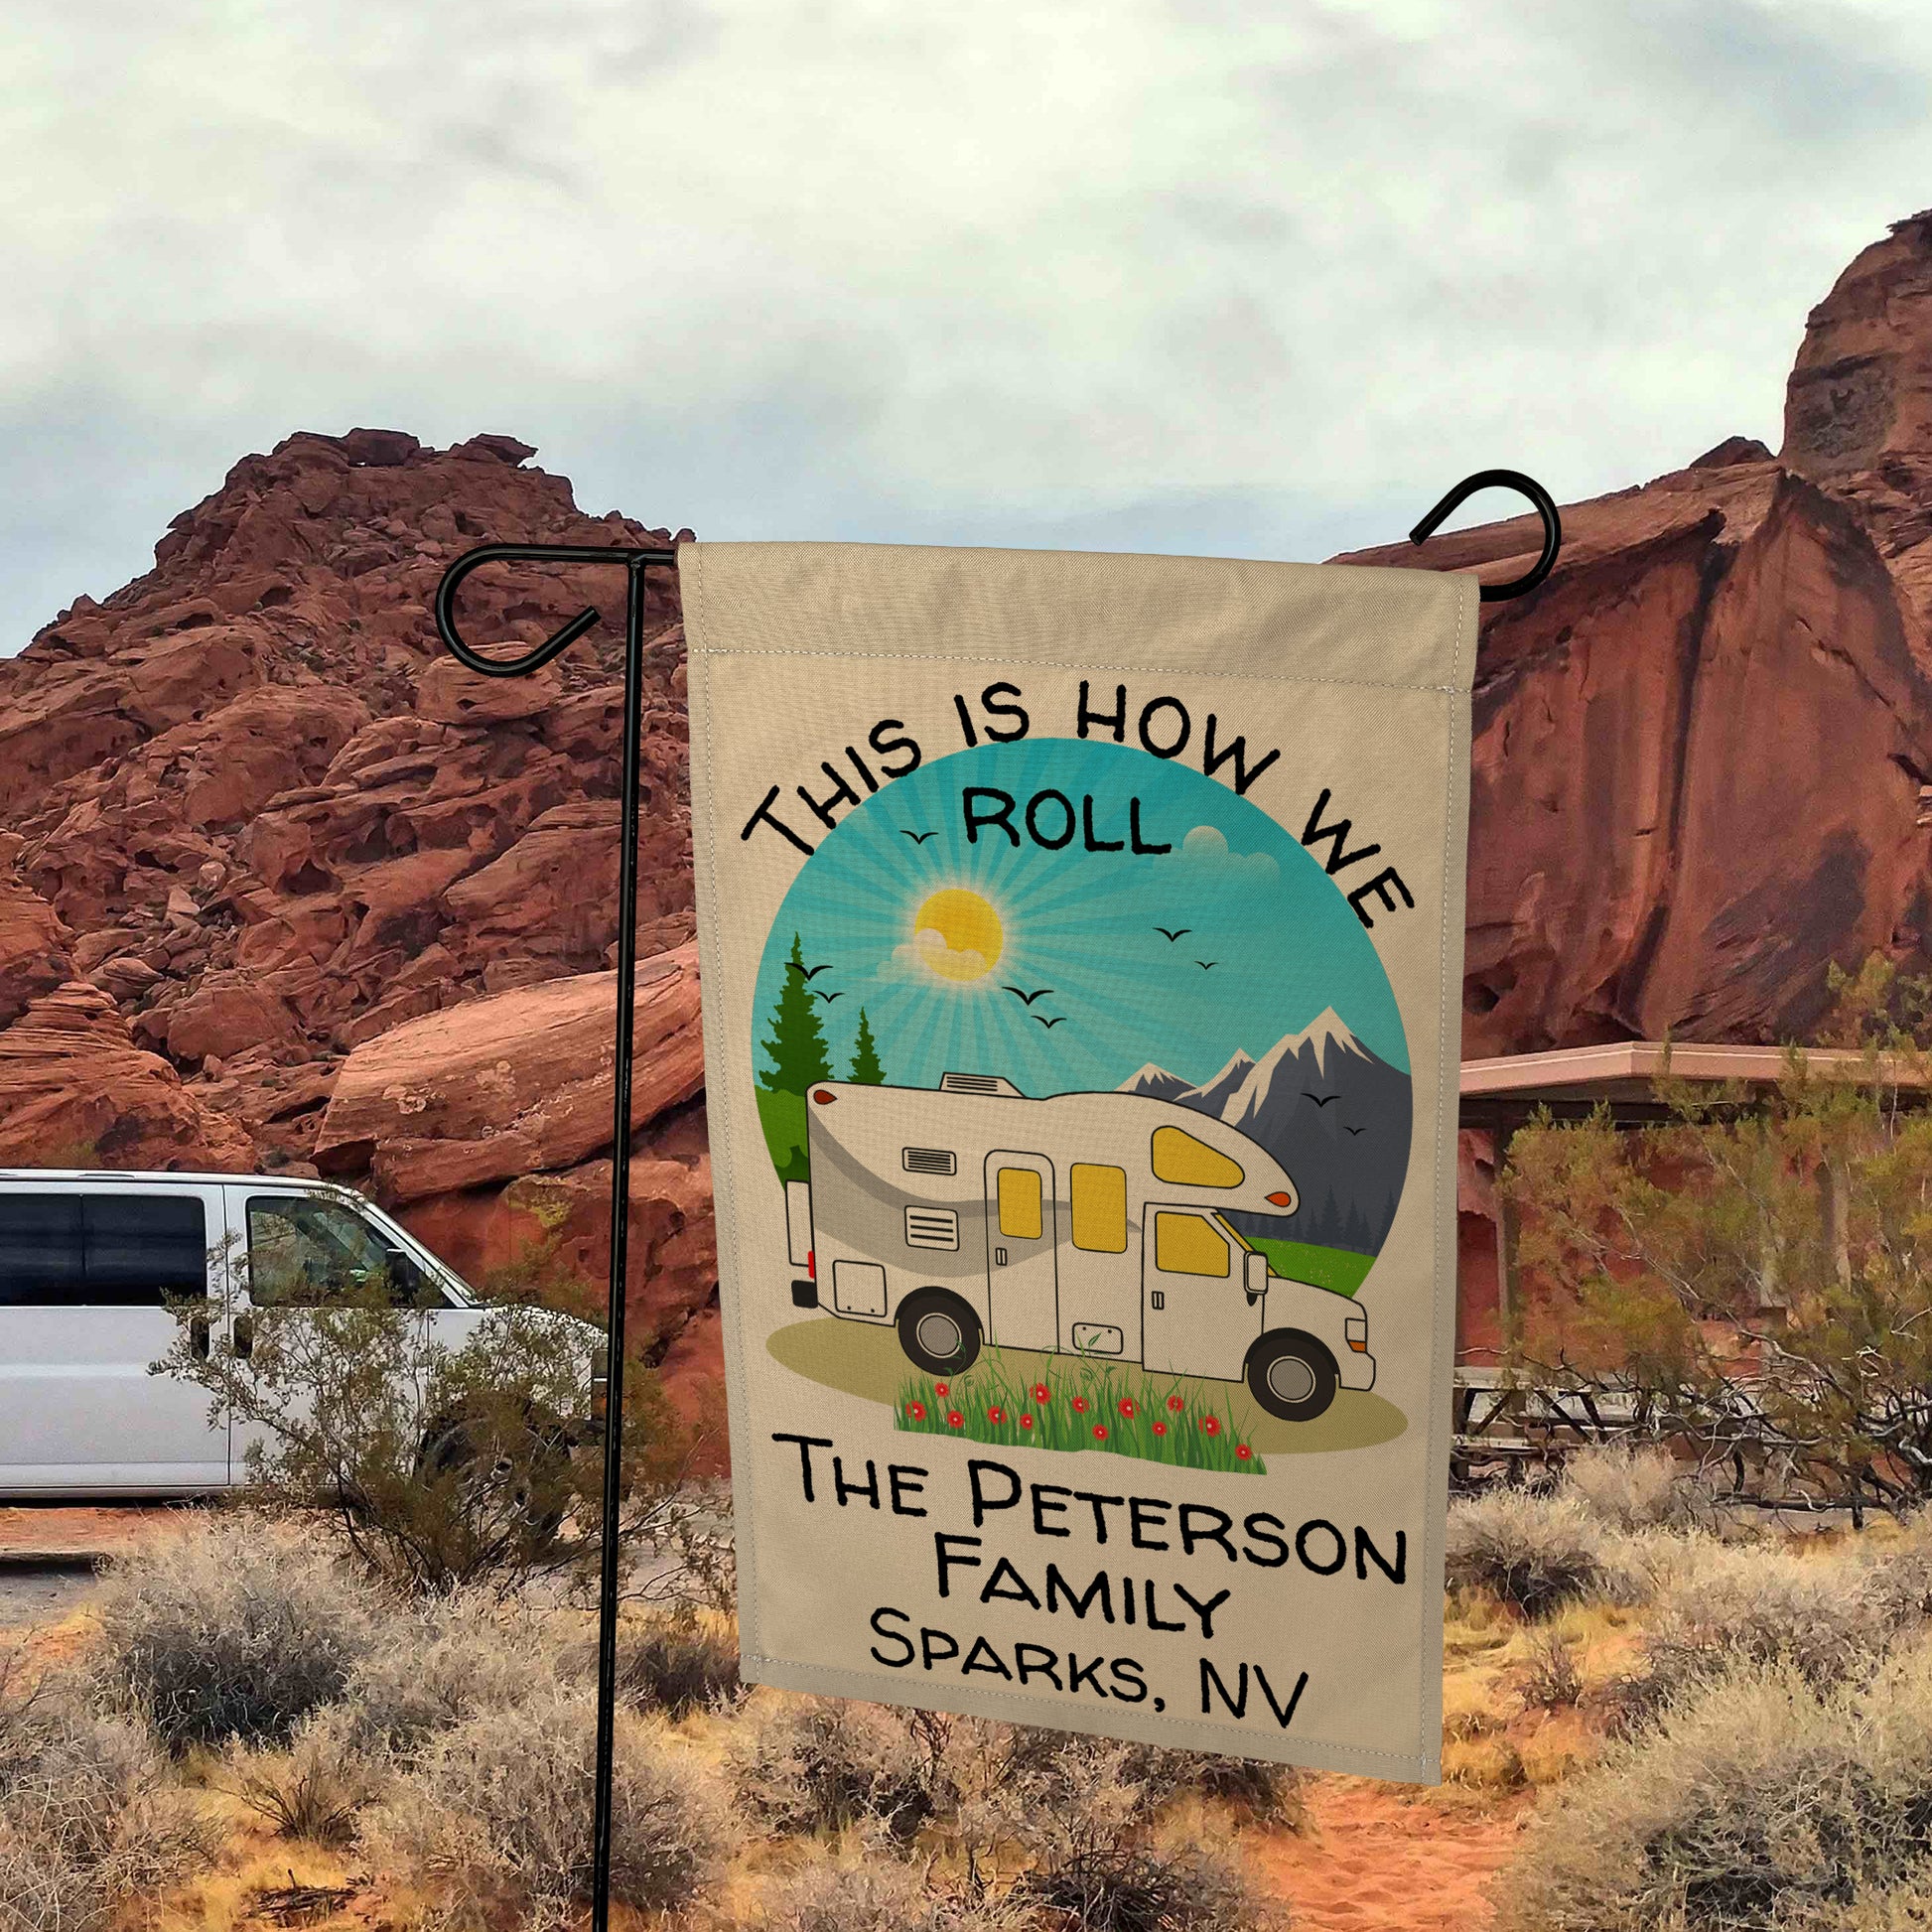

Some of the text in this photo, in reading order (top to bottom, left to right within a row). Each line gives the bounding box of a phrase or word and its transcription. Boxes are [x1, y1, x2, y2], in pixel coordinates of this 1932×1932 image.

[742, 679, 1415, 929] THIS IS HOW WE
[962, 786, 1173, 856] ROLL
[771, 1433, 1407, 1585] THE PETERSON
[933, 1531, 1231, 1639] FAMILY
[870, 1606, 1310, 1729] SPARKS, NV
